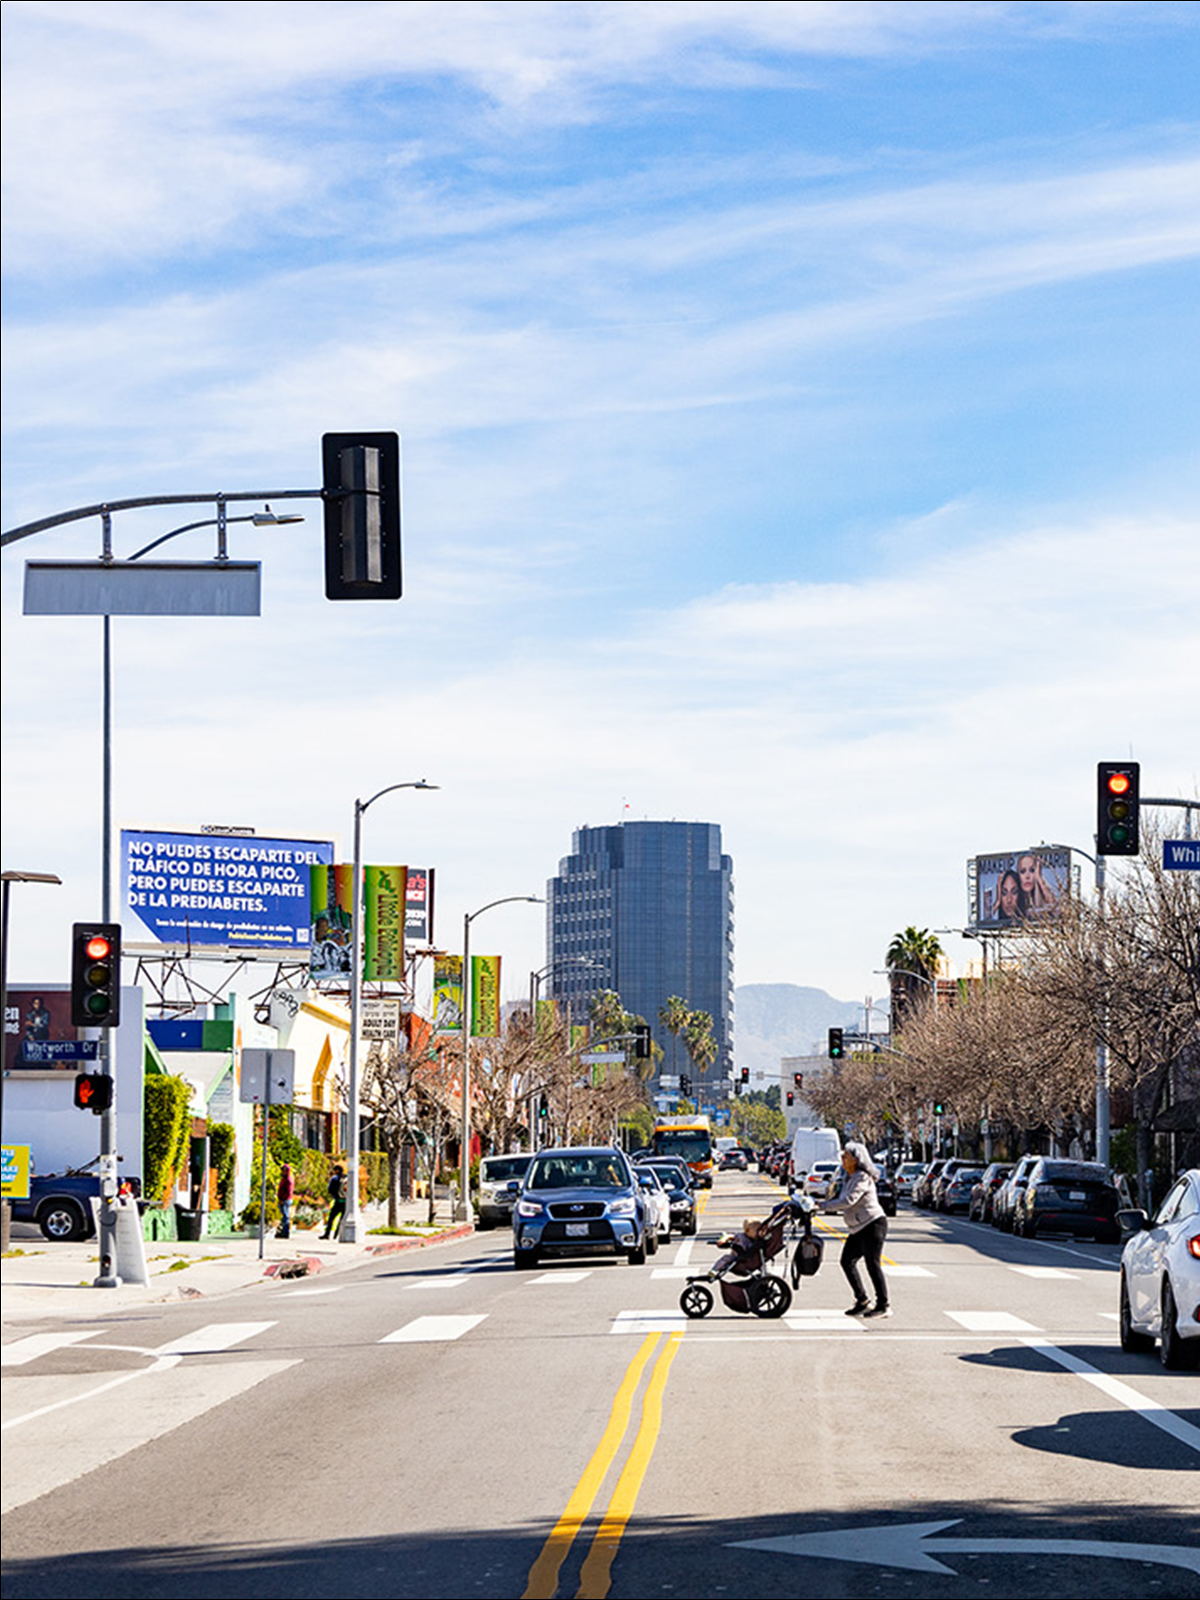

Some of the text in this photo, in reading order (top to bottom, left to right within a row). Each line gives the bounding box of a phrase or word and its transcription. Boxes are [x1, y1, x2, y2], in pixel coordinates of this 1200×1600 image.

[128, 841, 320, 865] NO PUEDES ESCAPARTE DEL
[128, 855, 300, 882] TRÁFICO DE HORA PICO,
[128, 875, 305, 897] PERO PUEDES ESCAPARTE
[127, 892, 268, 912] DE LA PREDIABETES.
[82, 1042, 94, 1053] Dr
